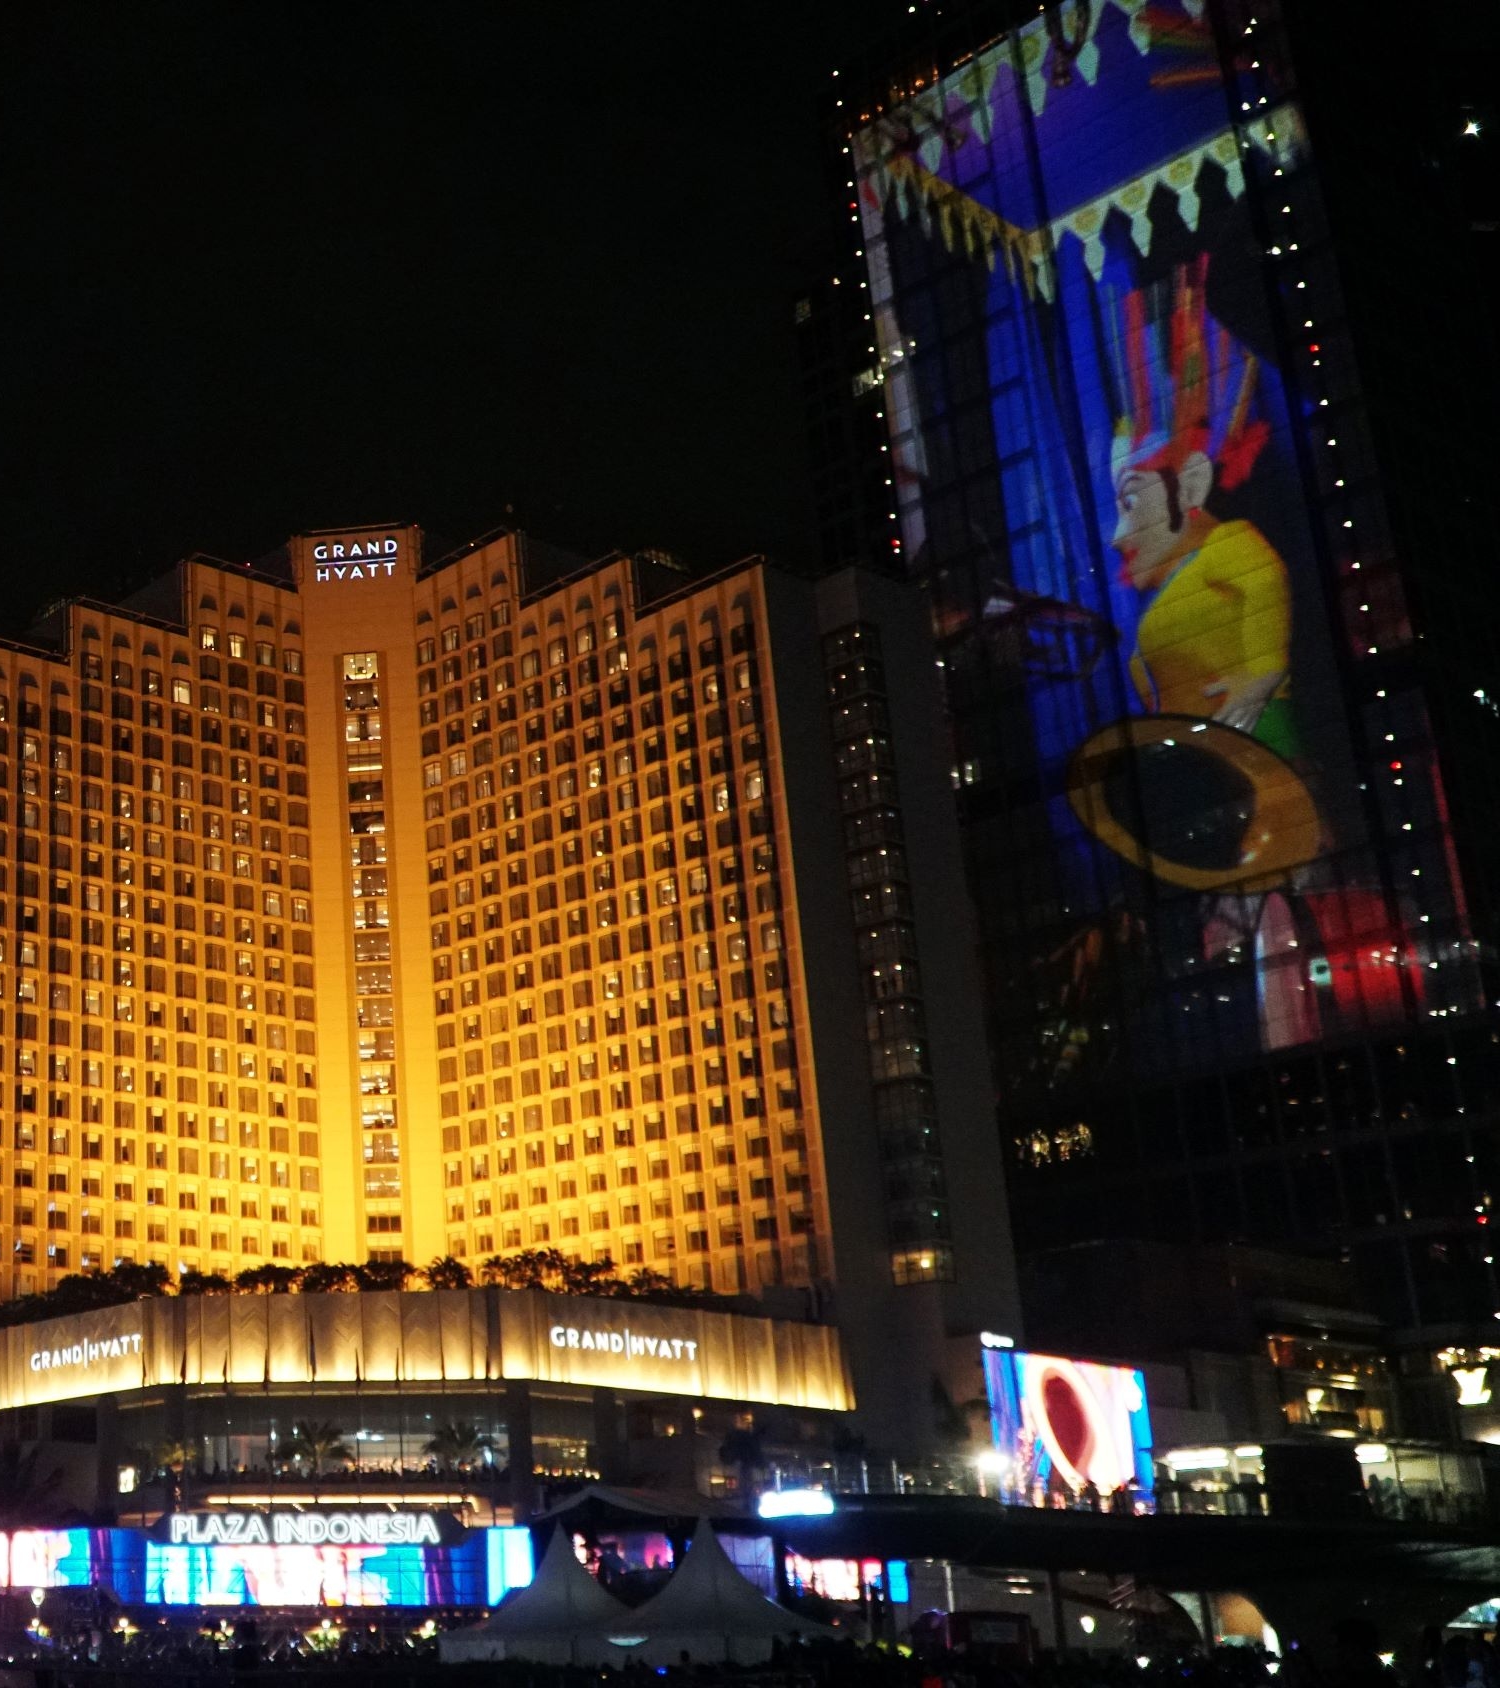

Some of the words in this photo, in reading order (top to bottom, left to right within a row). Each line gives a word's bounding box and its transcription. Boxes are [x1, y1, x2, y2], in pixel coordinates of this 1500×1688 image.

[314, 539, 398, 559] GRAND
[316, 562, 396, 582] HYATT
[169, 1513, 269, 1544] PLAZA
[272, 1512, 441, 1544] INDONESIA
